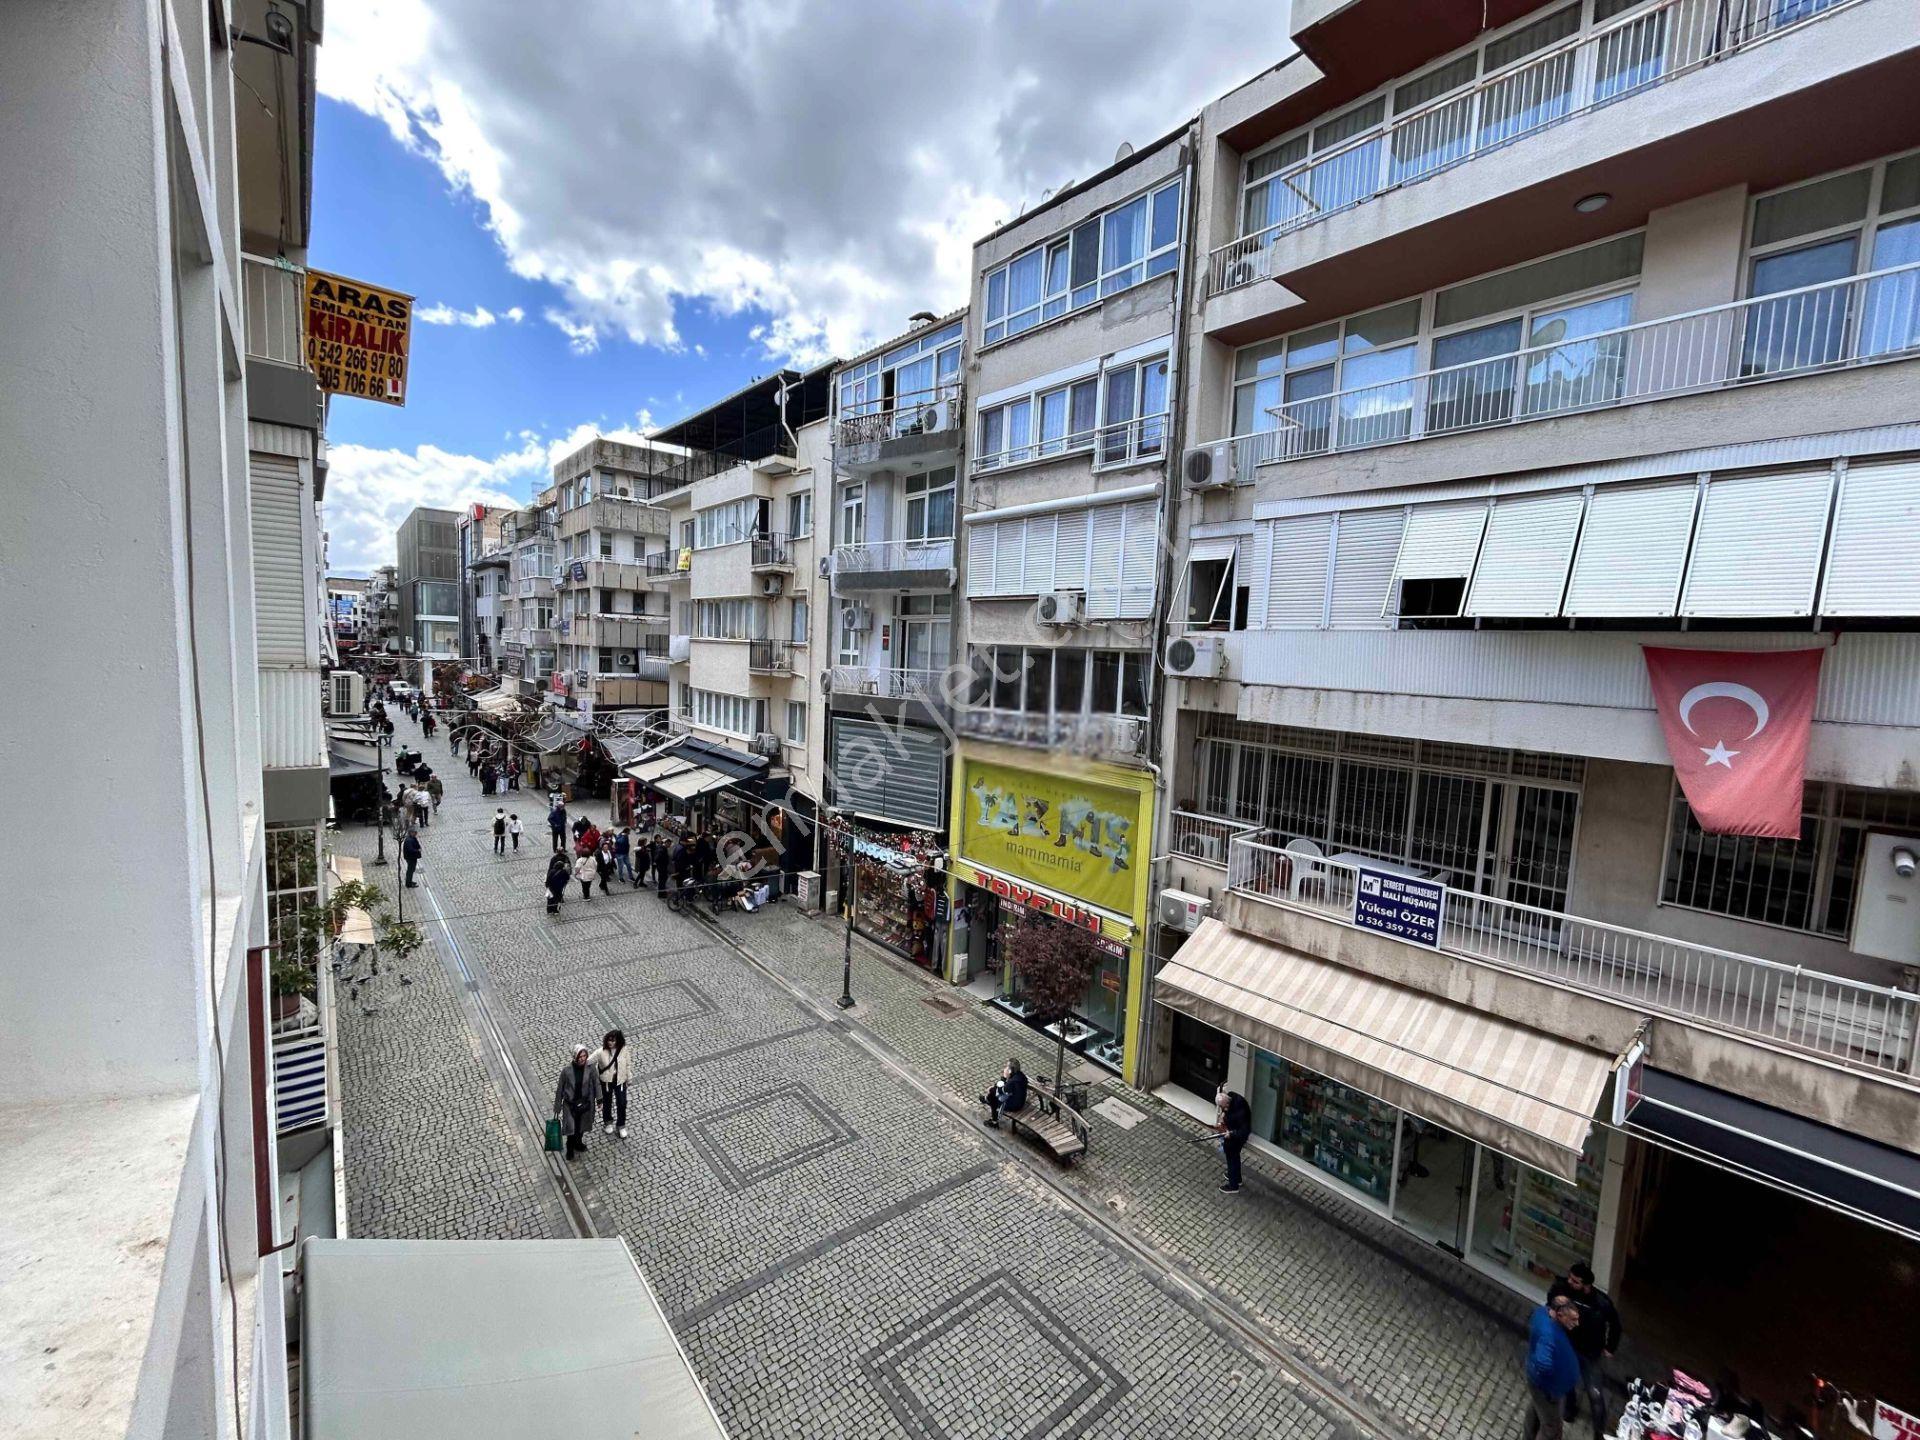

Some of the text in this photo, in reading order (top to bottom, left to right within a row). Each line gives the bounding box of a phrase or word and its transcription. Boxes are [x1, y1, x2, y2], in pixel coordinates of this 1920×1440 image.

[310, 297, 407, 331] EMLAK'TAN
[311, 278, 407, 319] ARAS
[309, 309, 406, 357] KİRALIK
[308, 338, 403, 379] 0 542 266 97 80
[318, 364, 384, 398] 505 706 66
[1006, 841, 1082, 874] mammamia
[973, 870, 1101, 934] TAYFUN
[1359, 899, 1435, 928] Yüksel ÖZER
[1382, 890, 1438, 911] MALİ MÜŞAVİR
[1357, 914, 1434, 941] 0 536 359 72 45
